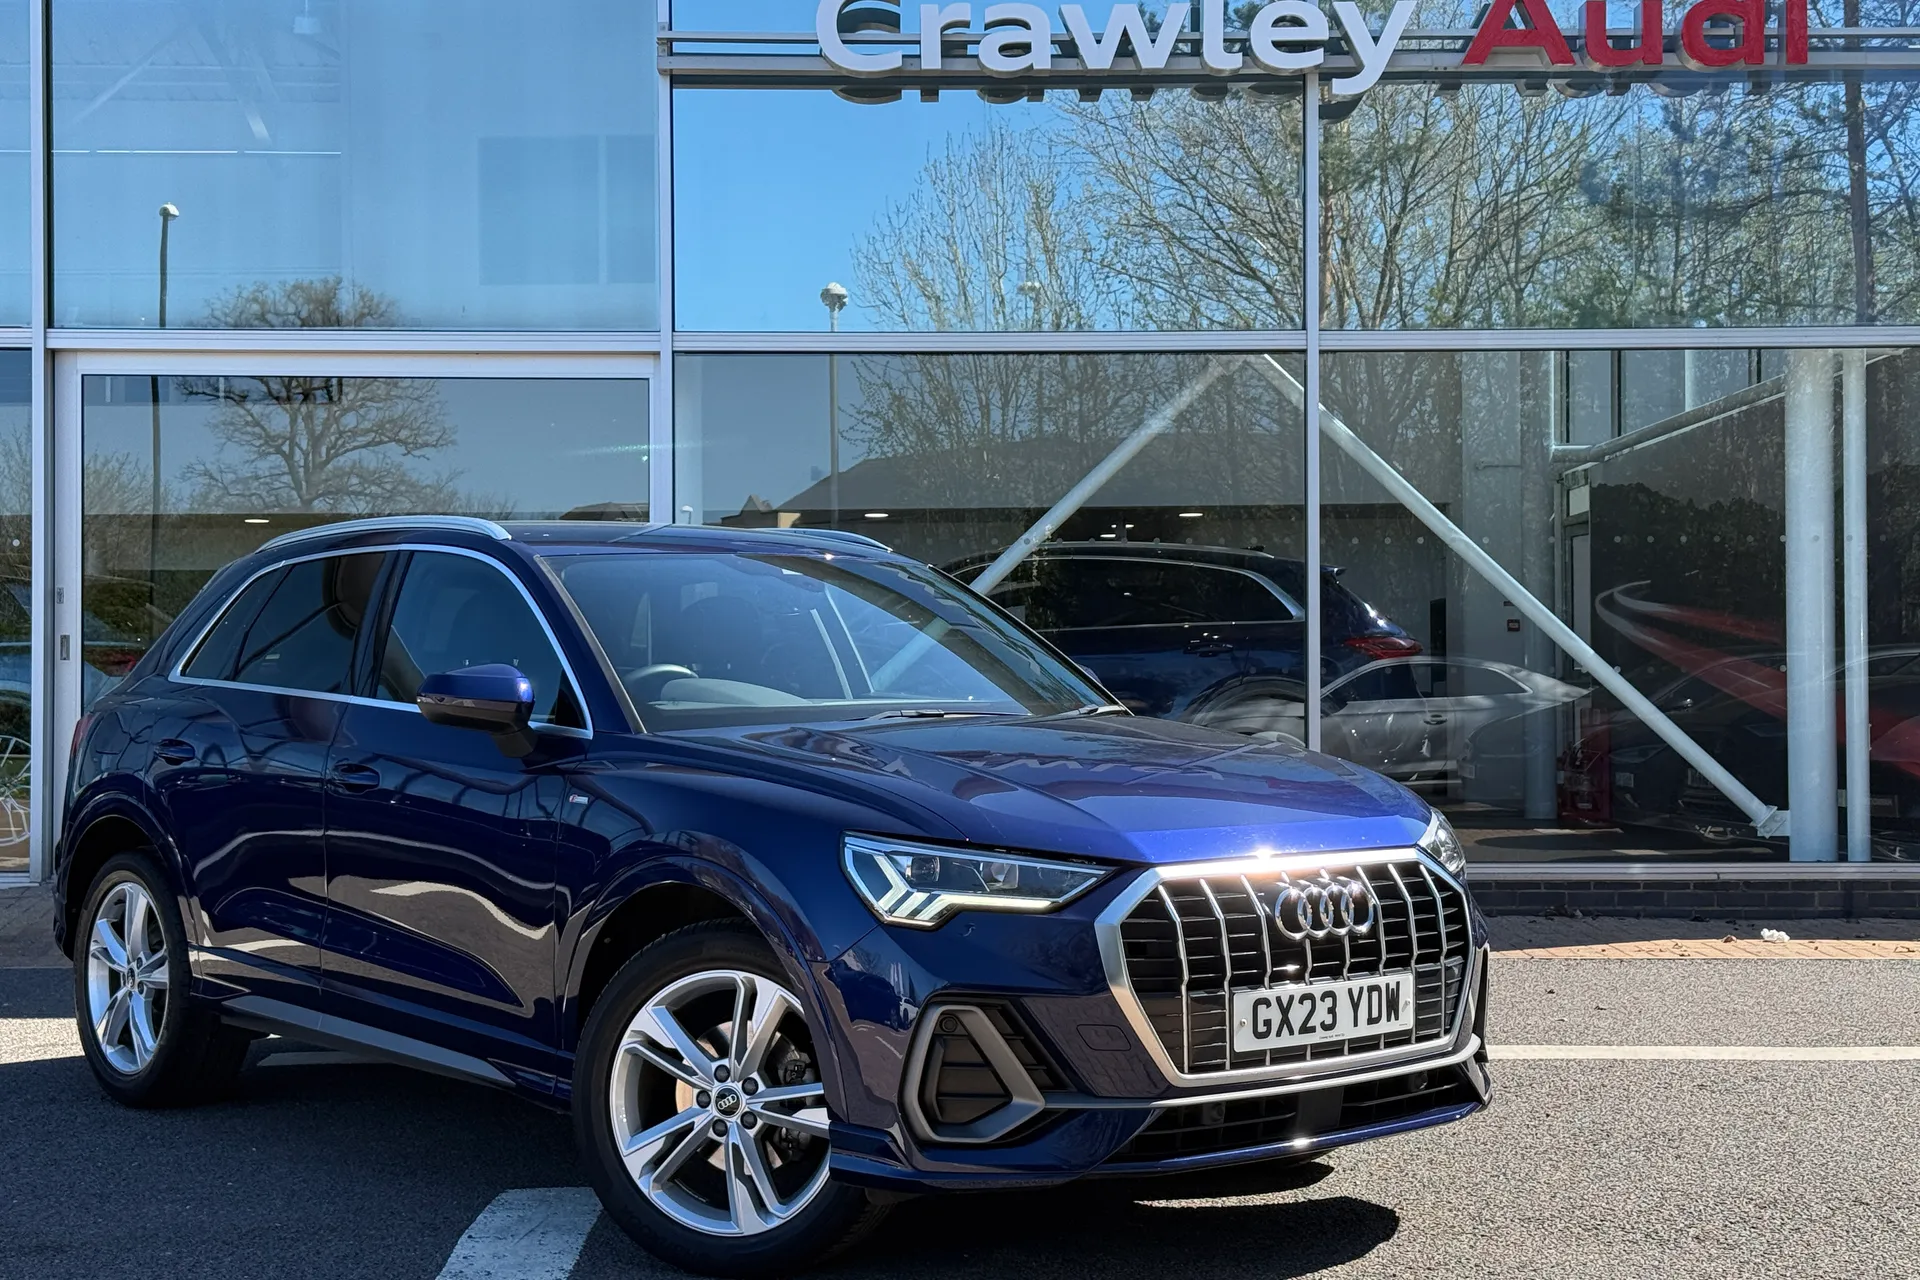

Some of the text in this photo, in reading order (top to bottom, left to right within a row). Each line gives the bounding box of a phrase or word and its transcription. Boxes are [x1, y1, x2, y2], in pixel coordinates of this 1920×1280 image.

[816, 0, 1809, 96] Crawley Audi
[1252, 980, 1401, 1040] GX23 YDW
